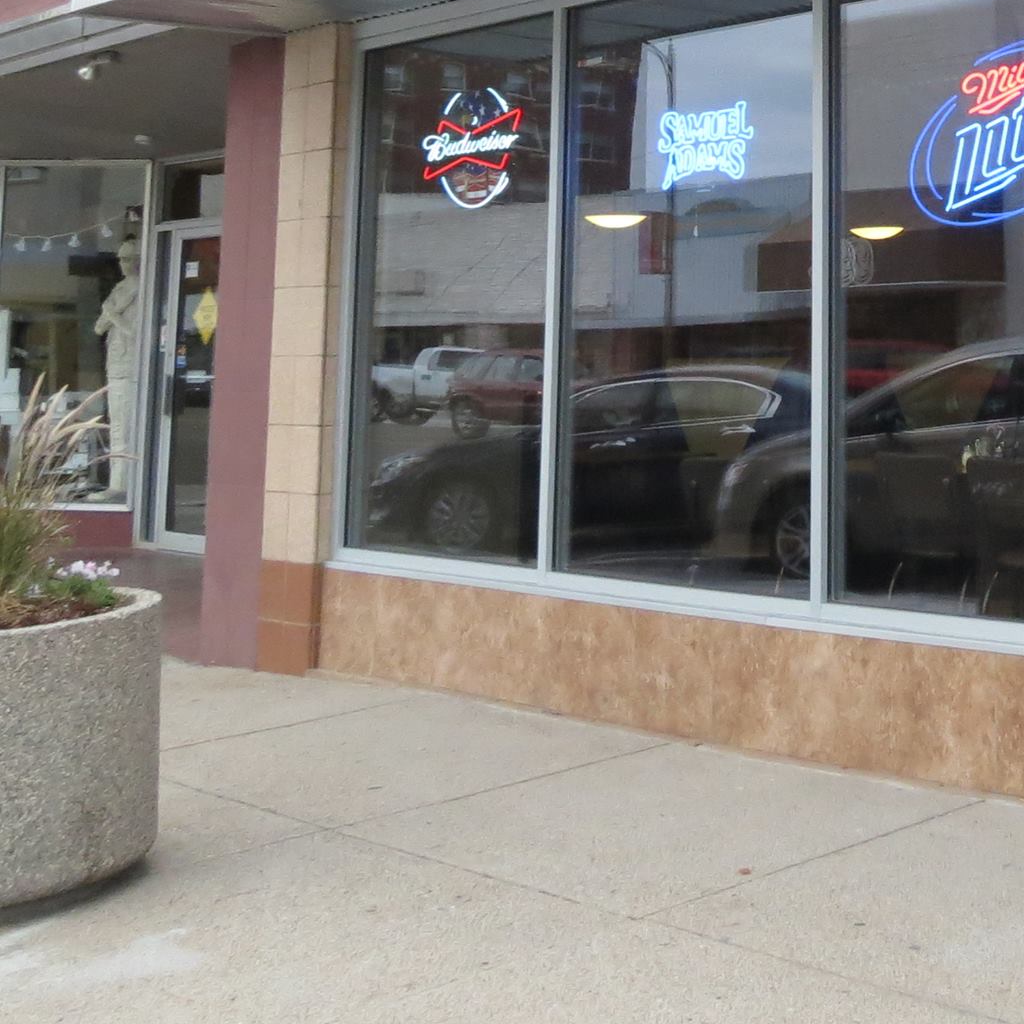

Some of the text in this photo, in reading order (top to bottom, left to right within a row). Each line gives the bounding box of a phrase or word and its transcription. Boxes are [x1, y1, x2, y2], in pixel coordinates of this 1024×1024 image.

[422, 132, 520, 163] Budweiser
[658, 100, 754, 154] SAMUEL
[661, 141, 747, 191] ADAMS
